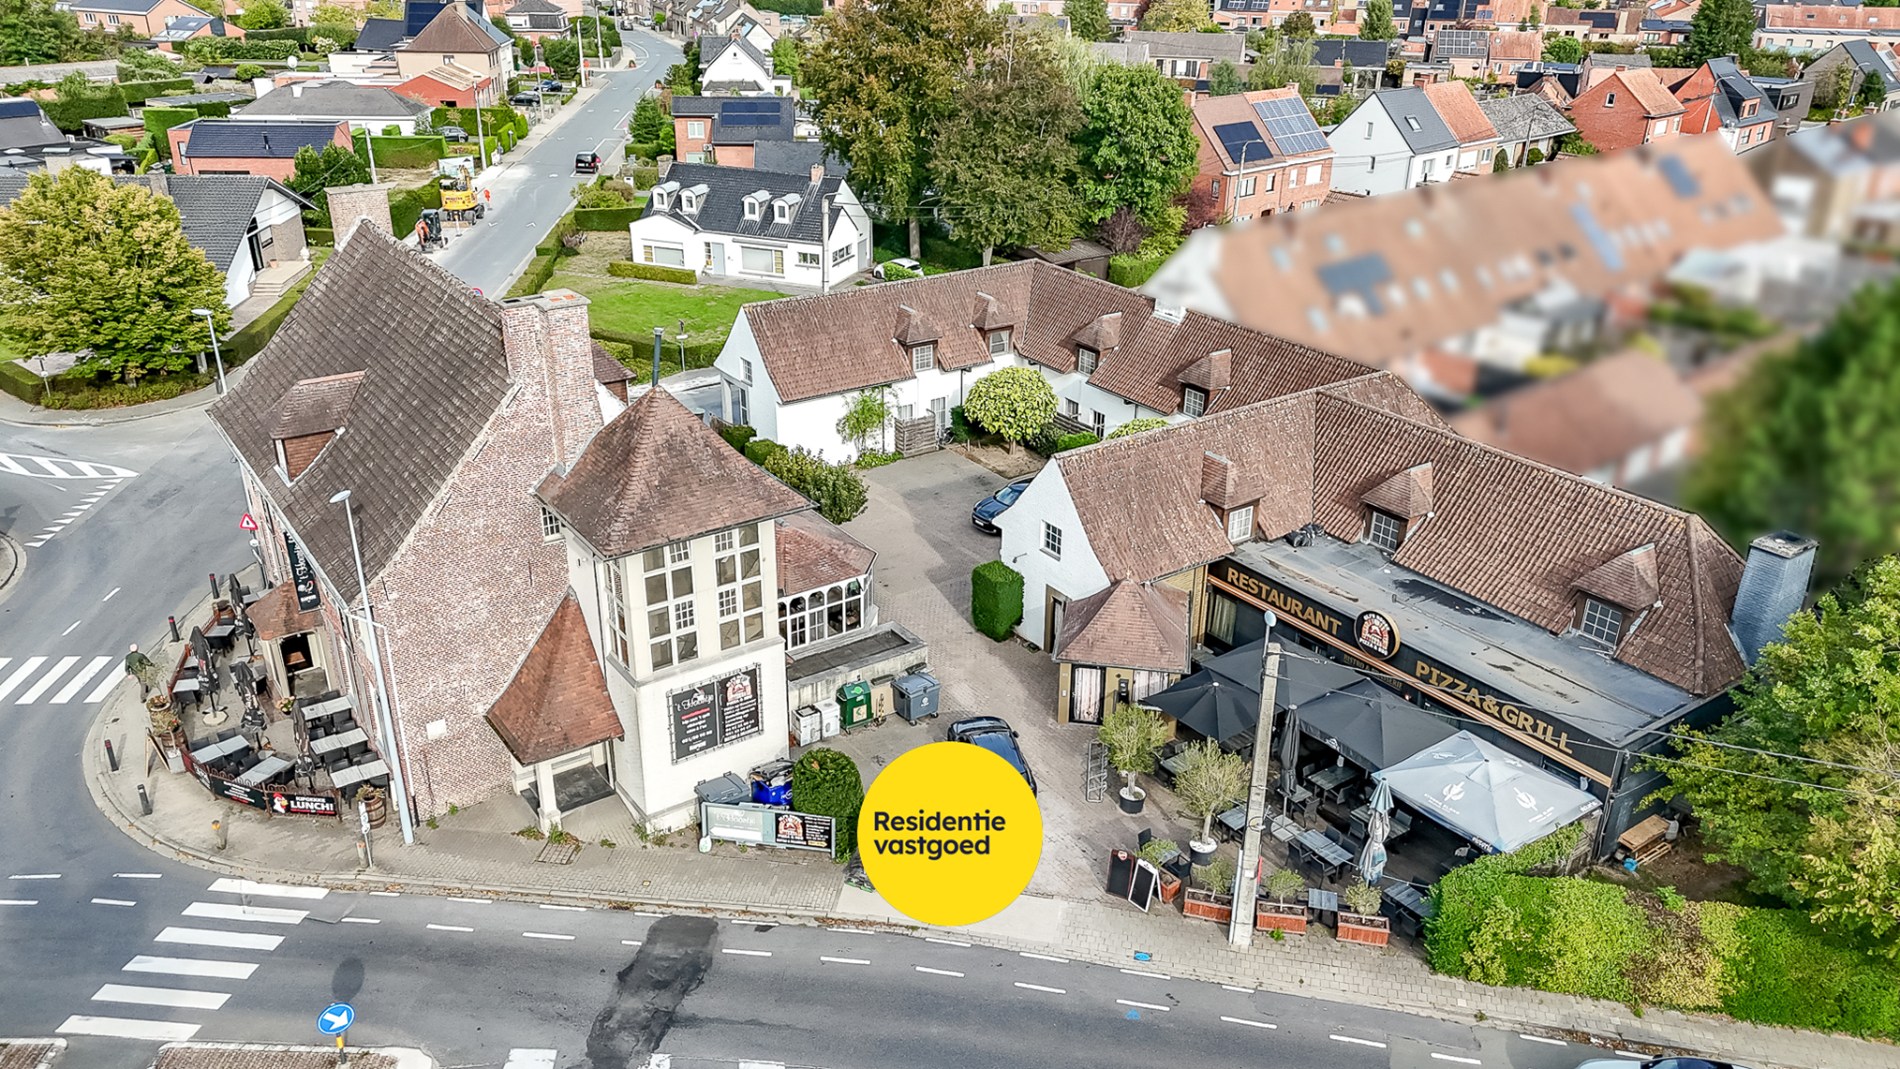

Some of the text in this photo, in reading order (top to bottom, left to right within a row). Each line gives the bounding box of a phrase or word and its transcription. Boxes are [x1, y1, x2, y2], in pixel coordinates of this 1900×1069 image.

[1227, 567, 1342, 635] RESTAURANT
[1415, 660, 1573, 754] PIZZA&GRILL
[290, 800, 334, 811] LUNCH!
